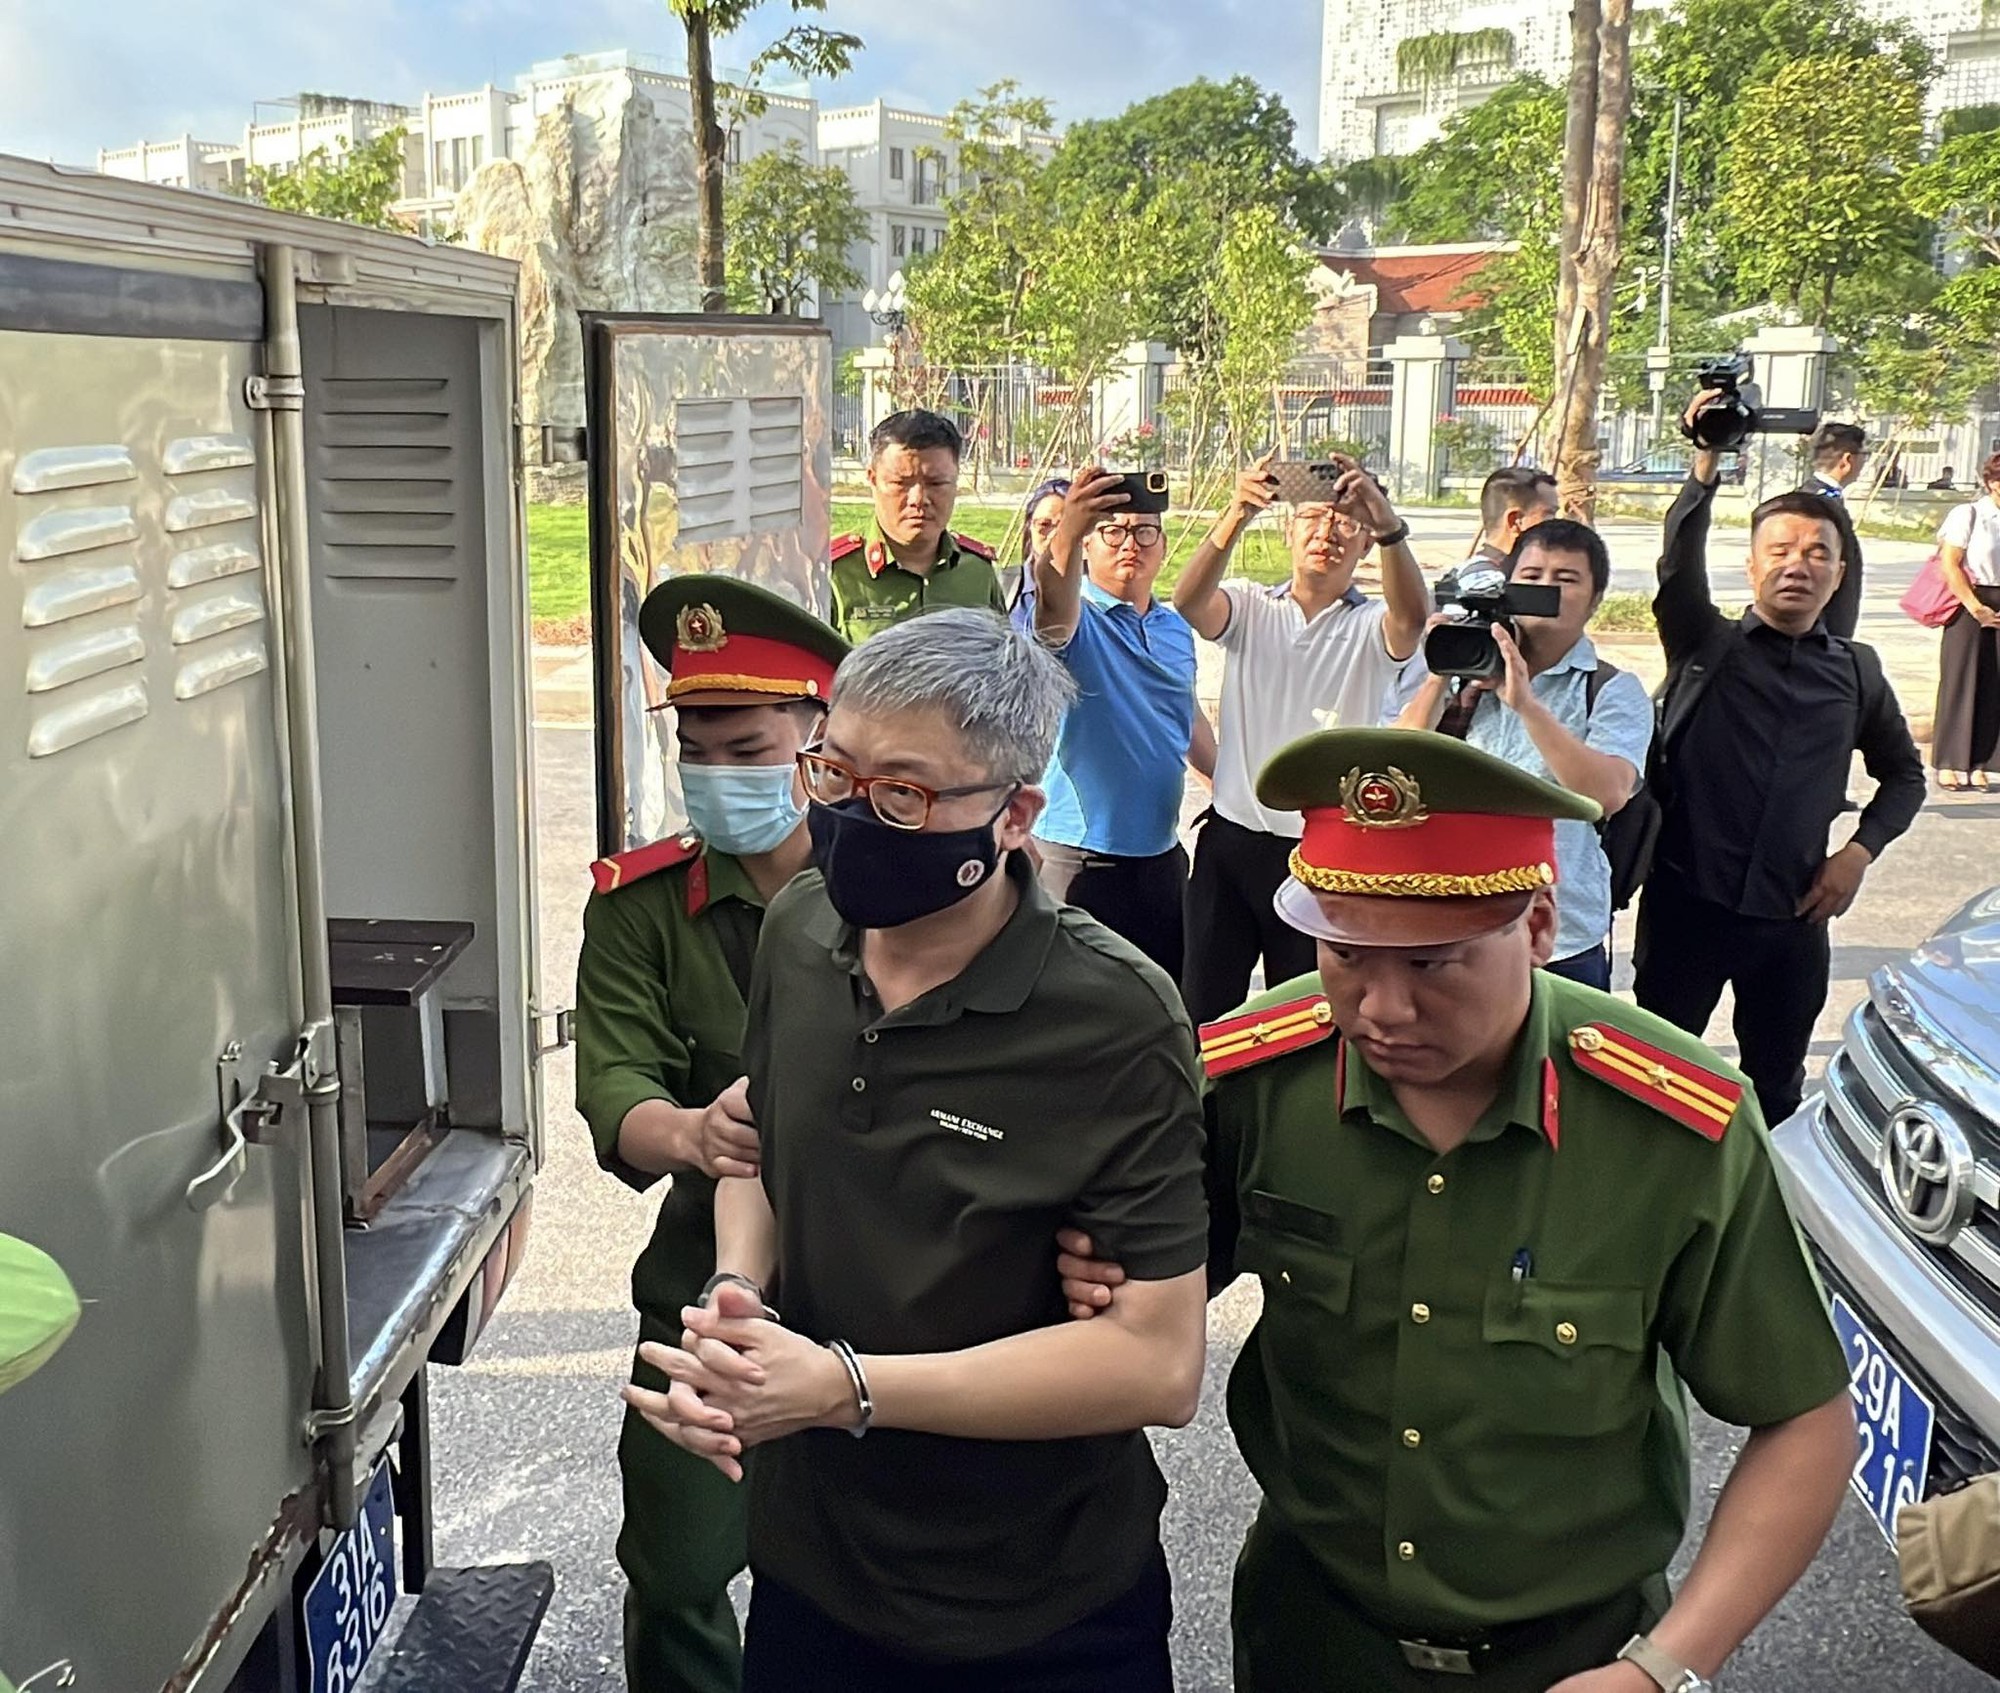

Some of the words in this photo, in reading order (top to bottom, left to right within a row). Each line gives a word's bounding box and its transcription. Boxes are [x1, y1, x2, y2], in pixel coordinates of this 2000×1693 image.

[961, 1118, 1004, 1140] EXCHANGE
[1849, 1333, 1900, 1450] 29A
[331, 1507, 376, 1625] 31A
